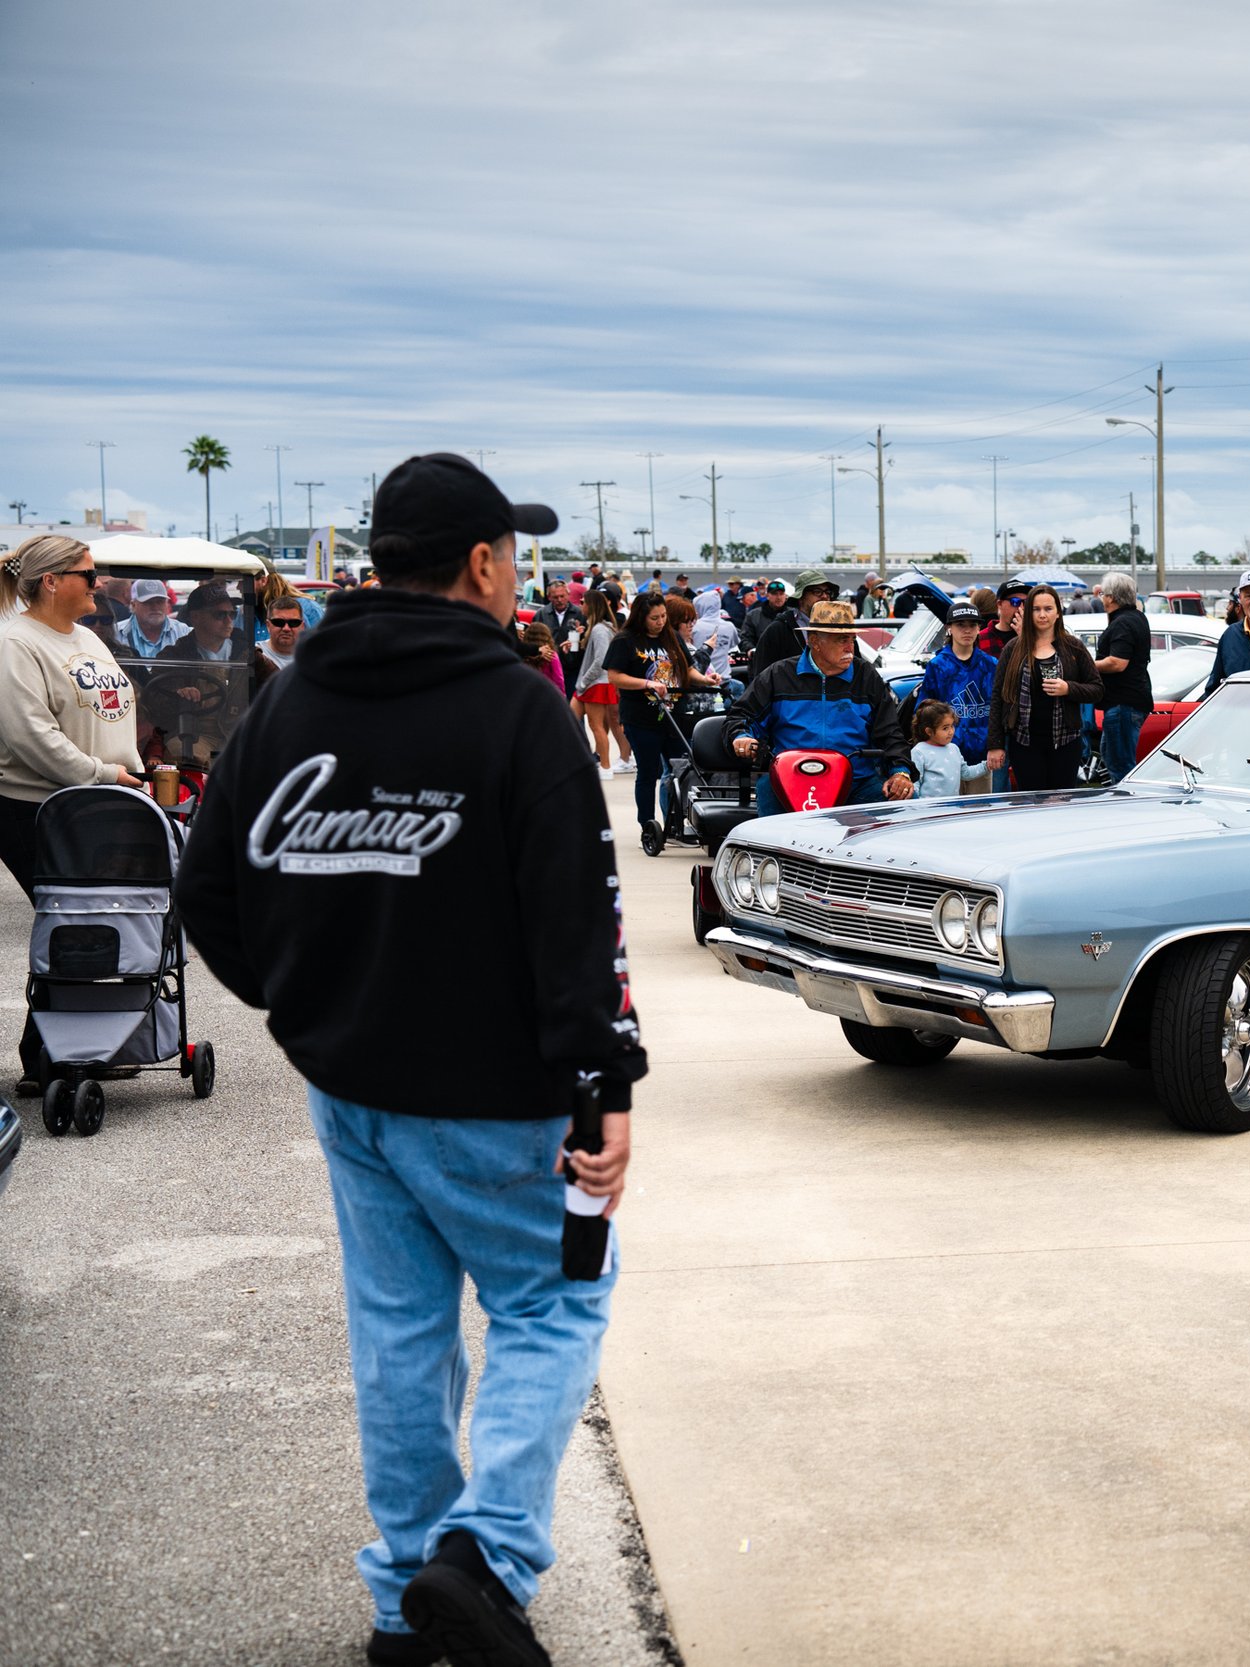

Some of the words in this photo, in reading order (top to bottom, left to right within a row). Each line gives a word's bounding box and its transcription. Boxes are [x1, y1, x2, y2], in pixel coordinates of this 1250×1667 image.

[69, 668, 130, 691] Coors
[93, 700, 130, 720] RODEO
[371, 786, 414, 806] Since
[416, 789, 466, 809] 1967
[247, 752, 463, 870] Camaro
